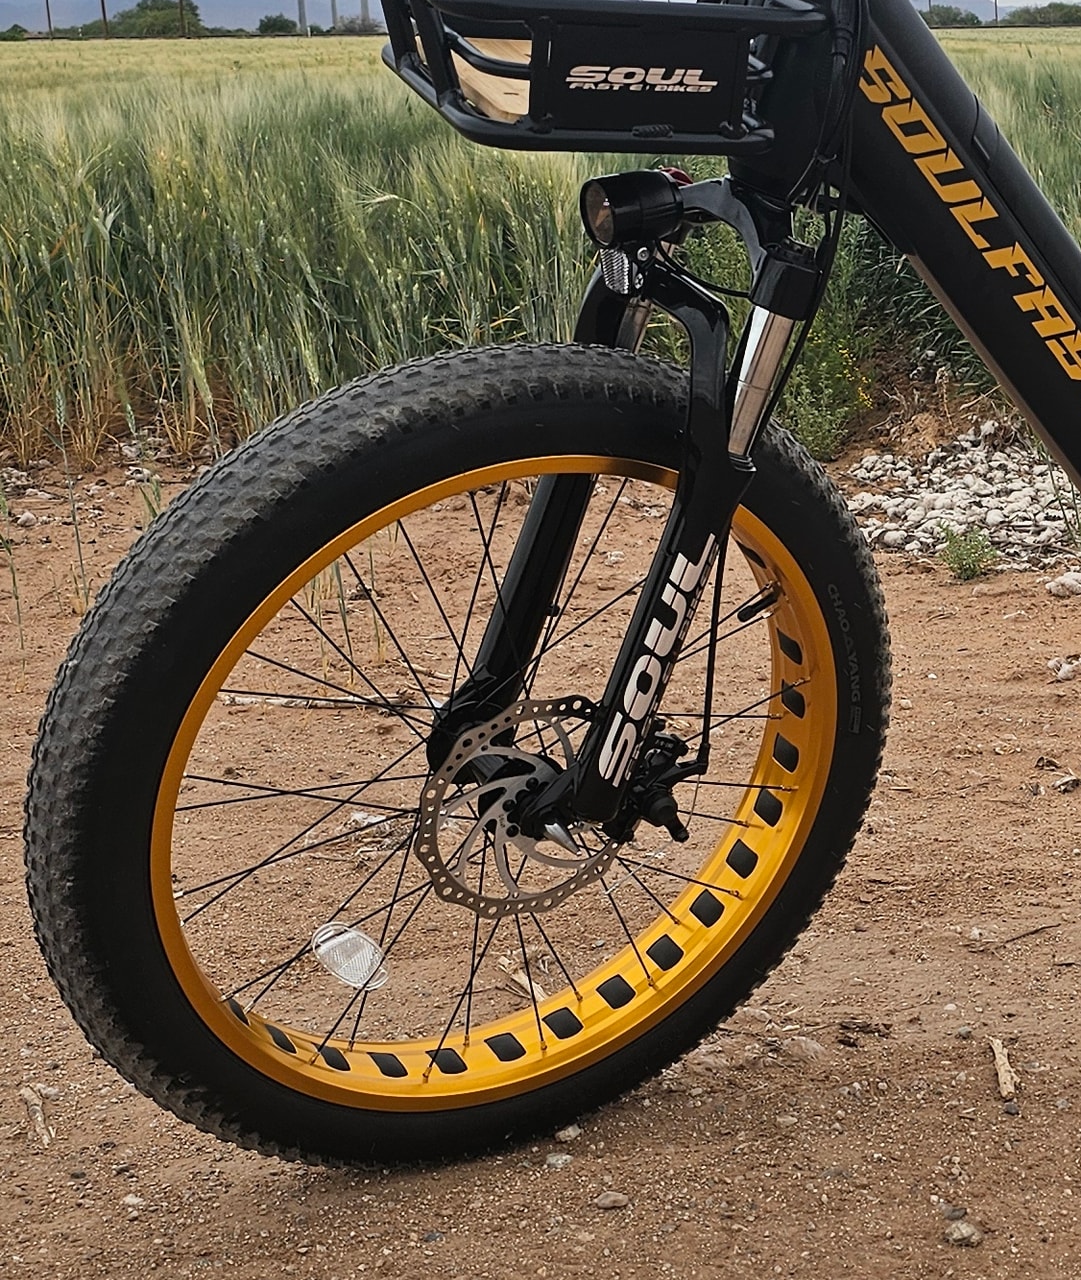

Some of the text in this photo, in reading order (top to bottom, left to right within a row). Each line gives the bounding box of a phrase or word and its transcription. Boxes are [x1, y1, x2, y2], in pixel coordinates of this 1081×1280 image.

[565, 65, 718, 86] SOUL
[568, 82, 624, 92] FAST
[654, 84, 713, 93] BIKES
[599, 532, 715, 789] SOUL
